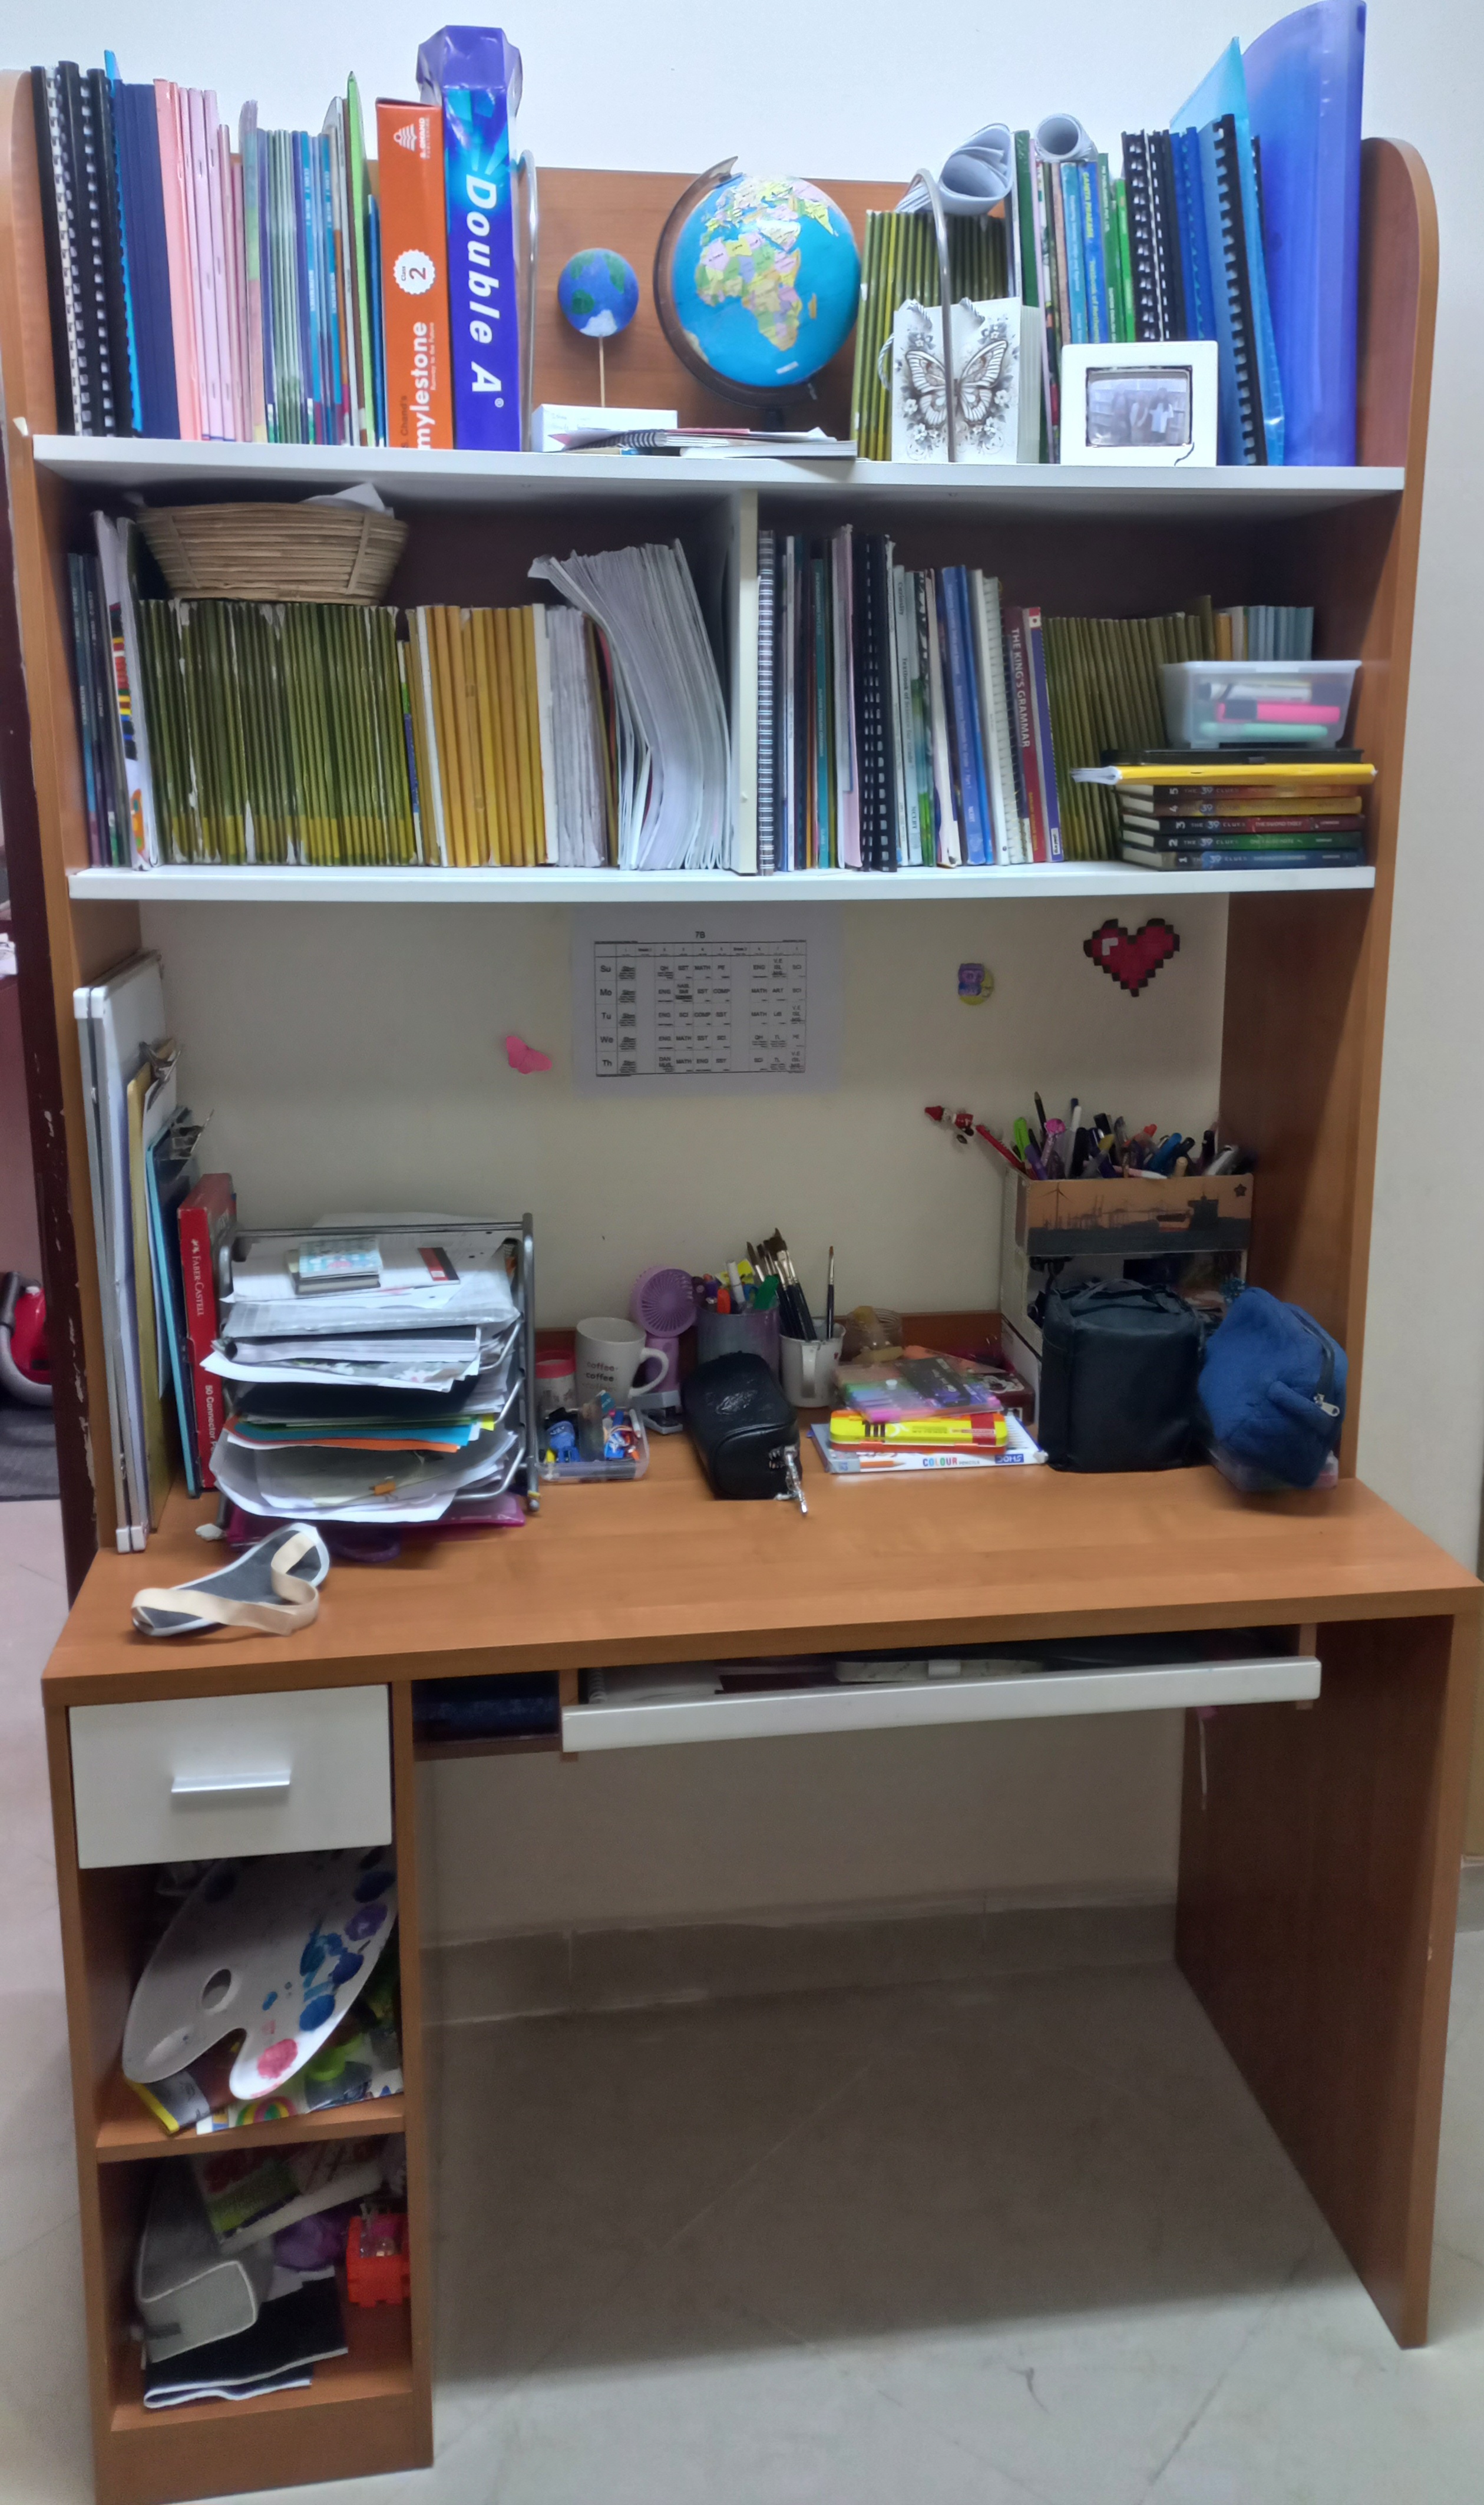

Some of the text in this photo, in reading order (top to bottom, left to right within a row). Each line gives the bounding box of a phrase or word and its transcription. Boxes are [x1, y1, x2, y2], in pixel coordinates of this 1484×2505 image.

[1083, 171, 1094, 238] GANITA PRAKASH
[409, 267, 427, 280] 2
[466, 174, 502, 392] Double A
[1092, 295, 1098, 305] of
[409, 322, 435, 450] mylestone
[399, 395, 408, 437] Chand's
[897, 582, 905, 616] Curiosity
[1010, 628, 1030, 748] THE KING'S GRAMMAR
[904, 701, 913, 728] Science
[1200, 804, 1214, 812] 39
[1175, 821, 1186, 829] 3
[1207, 820, 1220, 829] 39
[1168, 839, 1178, 847] 2
[1200, 837, 1214, 847] 39
[1209, 855, 1222, 863] 39
[191, 1255, 204, 1316] FABER-CASTELL
[587, 1362, 614, 1371] coffee
[586, 1372, 614, 1382] coffee
[205, 1384, 213, 1395] 50
[206, 1396, 216, 1439] Connector
[922, 1457, 958, 1467] COLOUR
